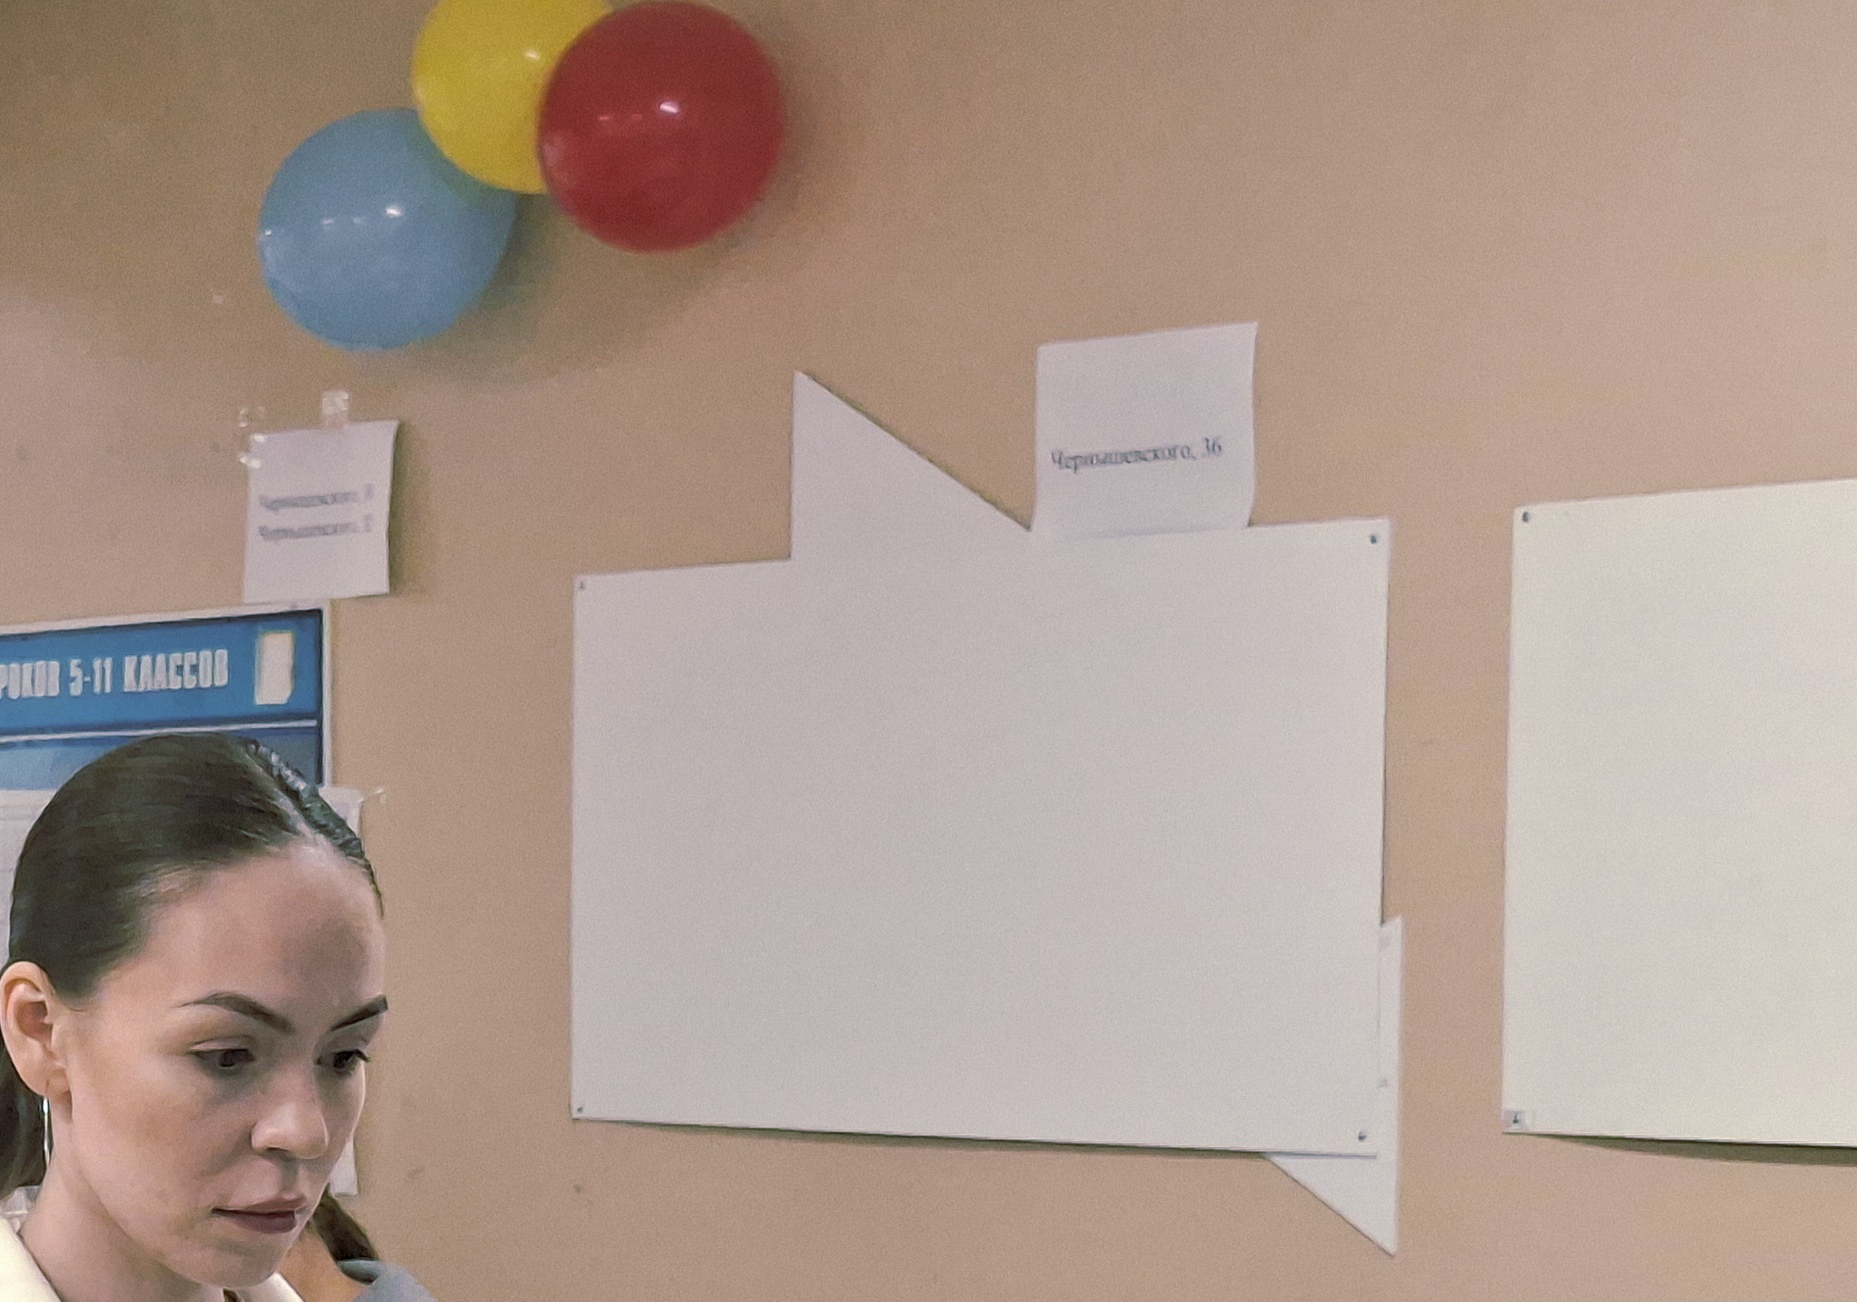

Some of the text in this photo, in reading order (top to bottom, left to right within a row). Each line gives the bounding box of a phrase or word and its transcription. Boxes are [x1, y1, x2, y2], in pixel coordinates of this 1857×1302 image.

[1202, 435, 1224, 458] 36
[69, 658, 113, 697] 5-11
[122, 649, 230, 693] КЛАССОВ
